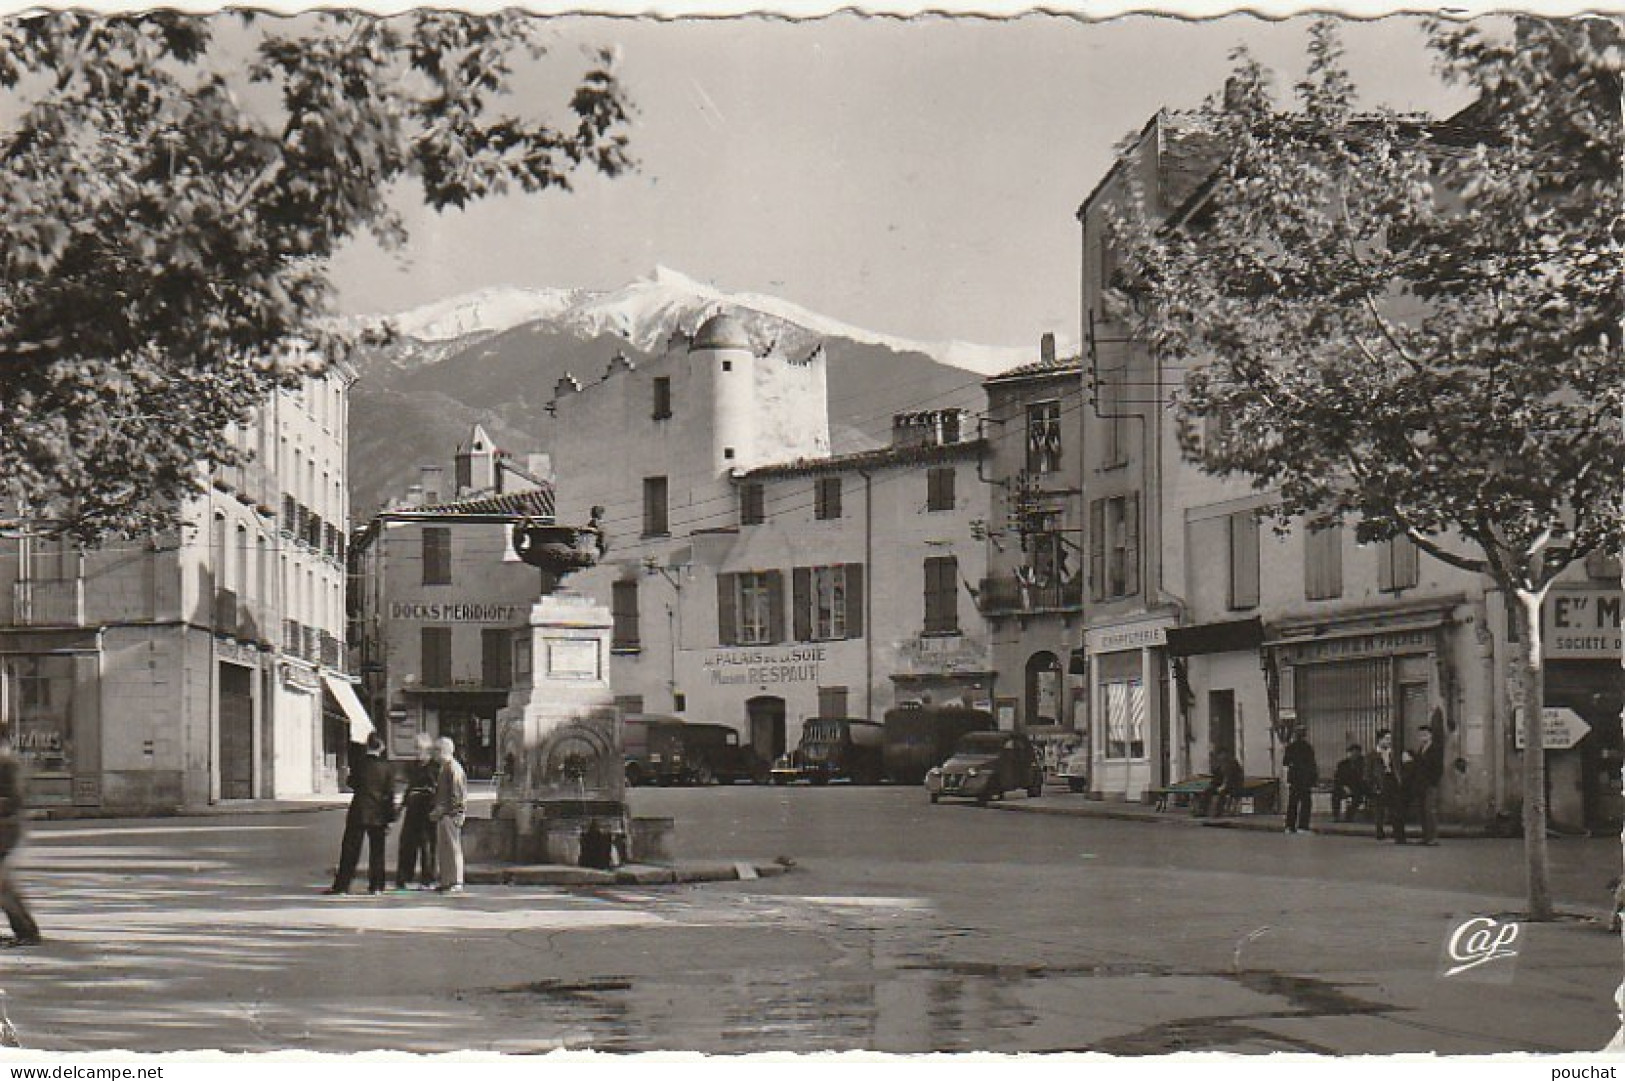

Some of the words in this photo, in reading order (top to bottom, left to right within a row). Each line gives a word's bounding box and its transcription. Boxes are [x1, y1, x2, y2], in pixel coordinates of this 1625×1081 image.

[392, 602, 440, 618] DOCKS
[716, 651, 762, 666] PALAIS
[792, 648, 827, 661] SOIE
[747, 665, 815, 684] RESPAUT
